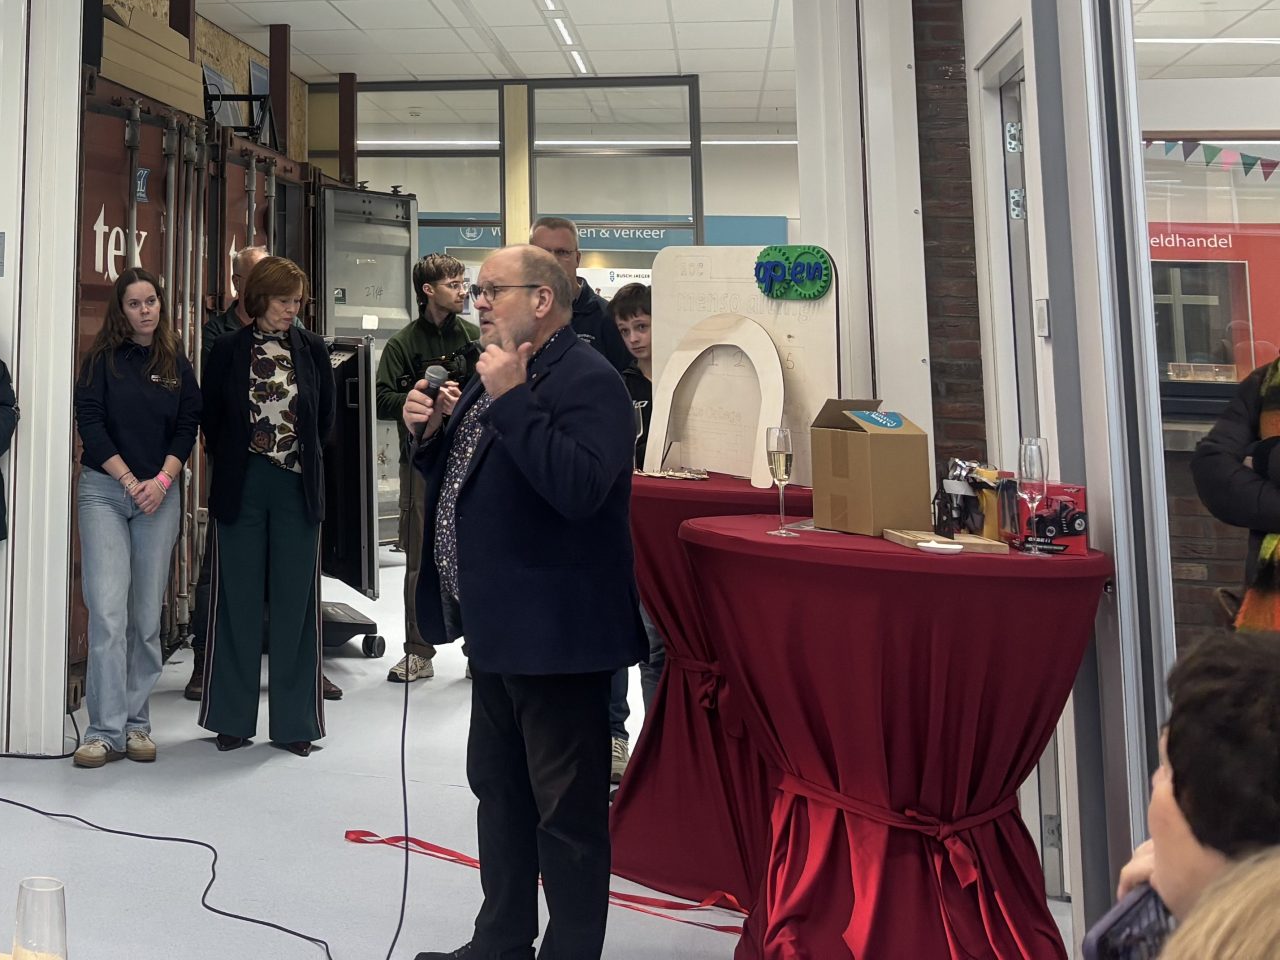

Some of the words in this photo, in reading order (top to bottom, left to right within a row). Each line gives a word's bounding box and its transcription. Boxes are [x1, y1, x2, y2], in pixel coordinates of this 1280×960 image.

[599, 227, 611, 238] &
[1150, 233, 1233, 248] eldhandel
[754, 259, 823, 294] open
[785, 351, 796, 370] 5
